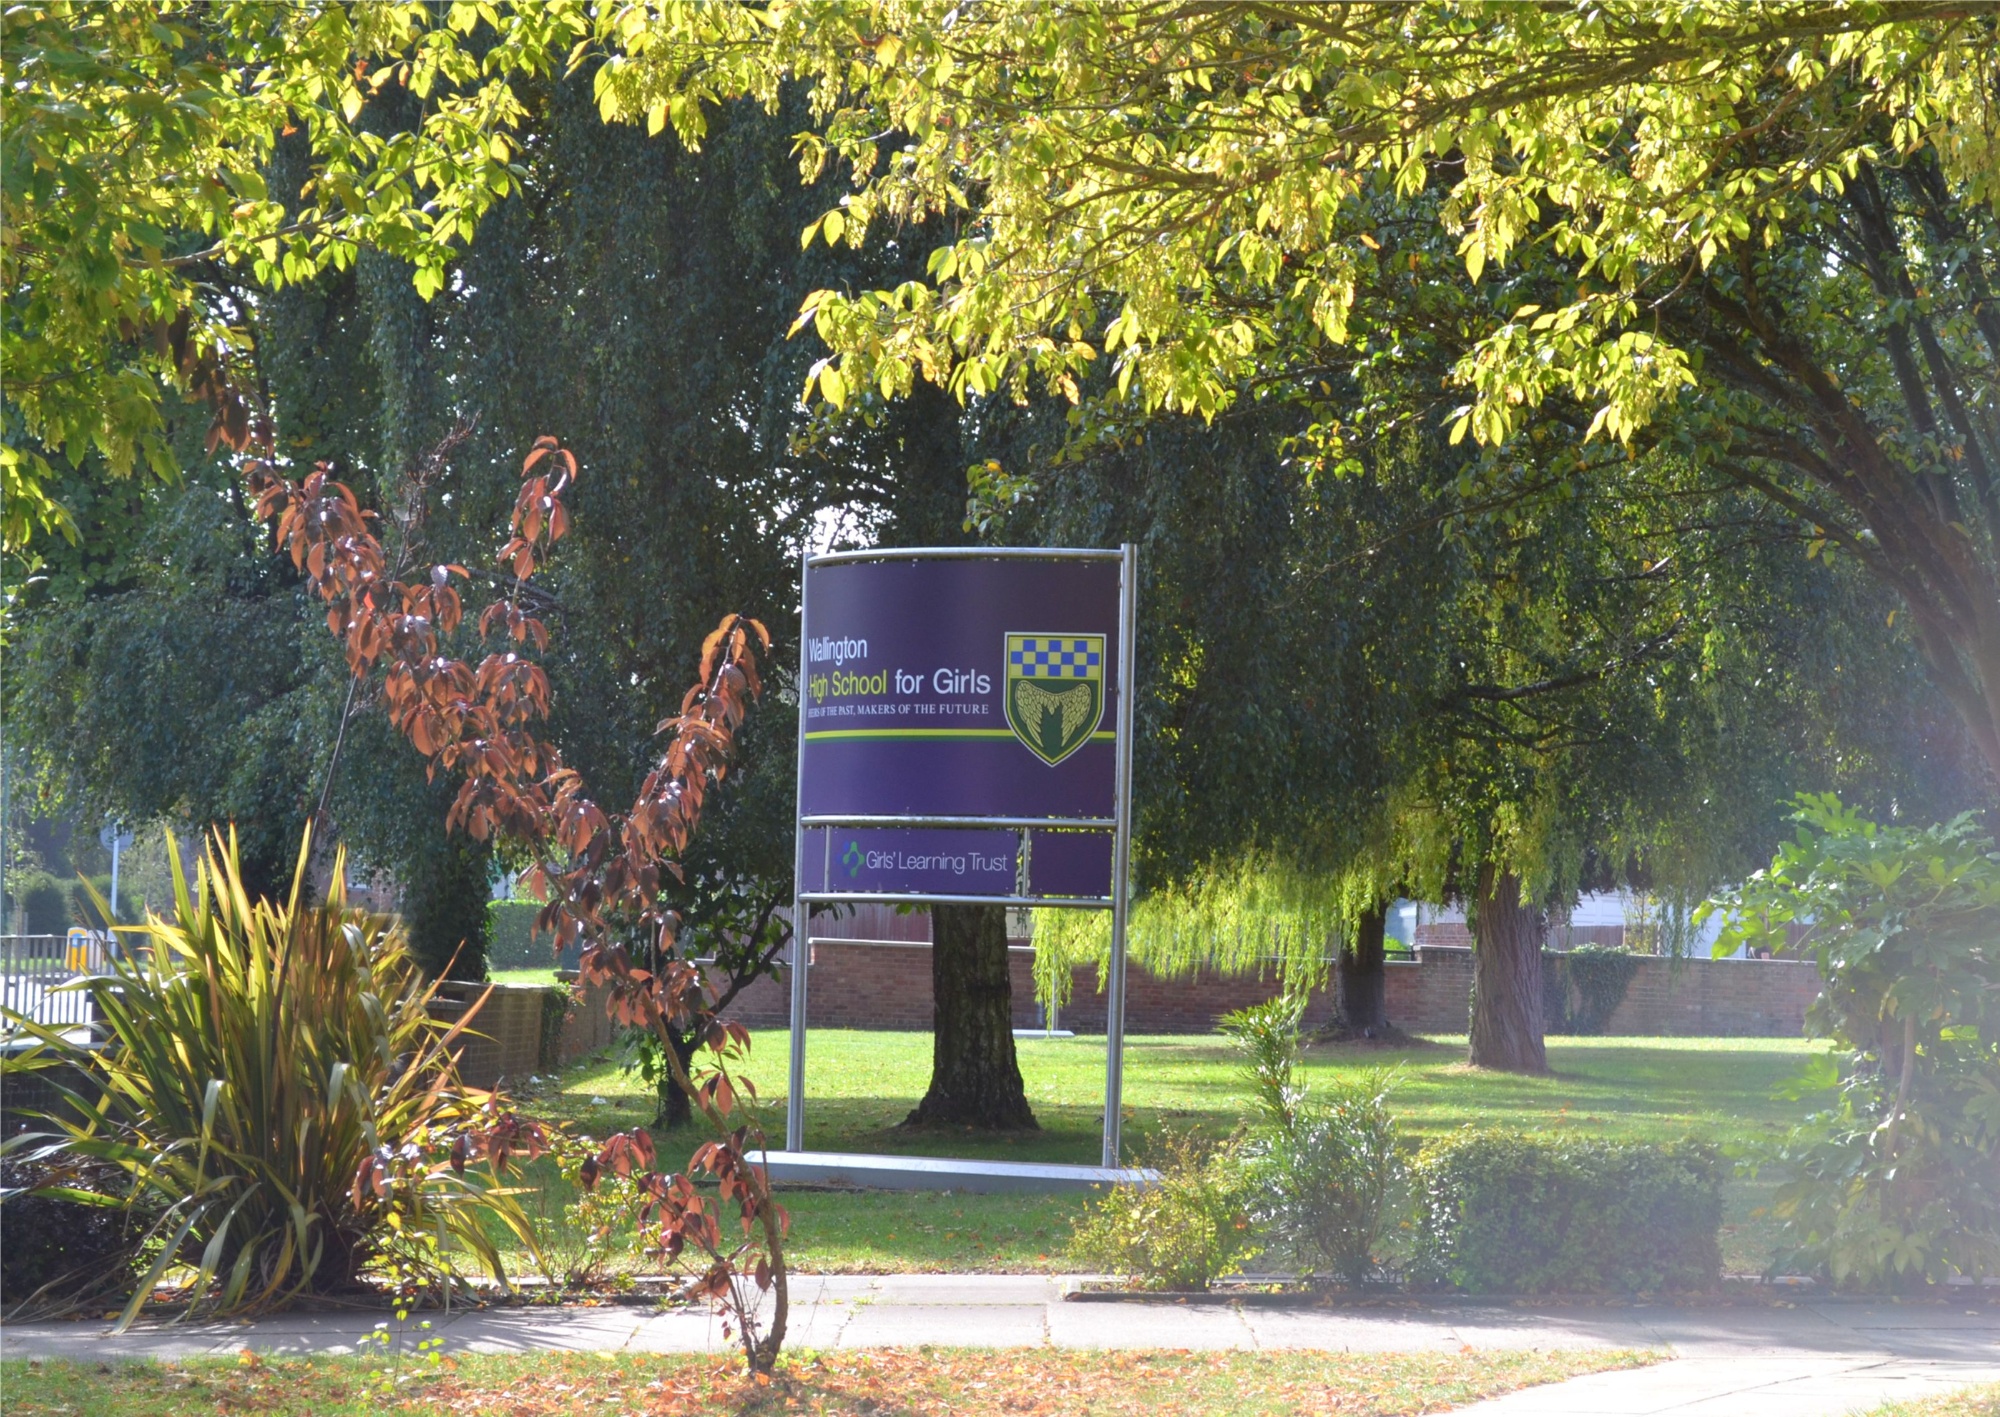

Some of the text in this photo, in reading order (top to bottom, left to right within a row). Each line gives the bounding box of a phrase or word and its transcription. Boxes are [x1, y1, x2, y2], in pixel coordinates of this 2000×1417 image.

[808, 636, 867, 666] Wallington
[809, 668, 991, 704] High School for Girls
[827, 706, 837, 716] THE
[838, 705, 856, 716] PAST,
[857, 704, 896, 715] MAKERS
[898, 704, 911, 714] OF
[914, 704, 936, 714] THE
[939, 703, 989, 714] FUTURE
[866, 850, 1008, 874] Girls' Learning Trust
